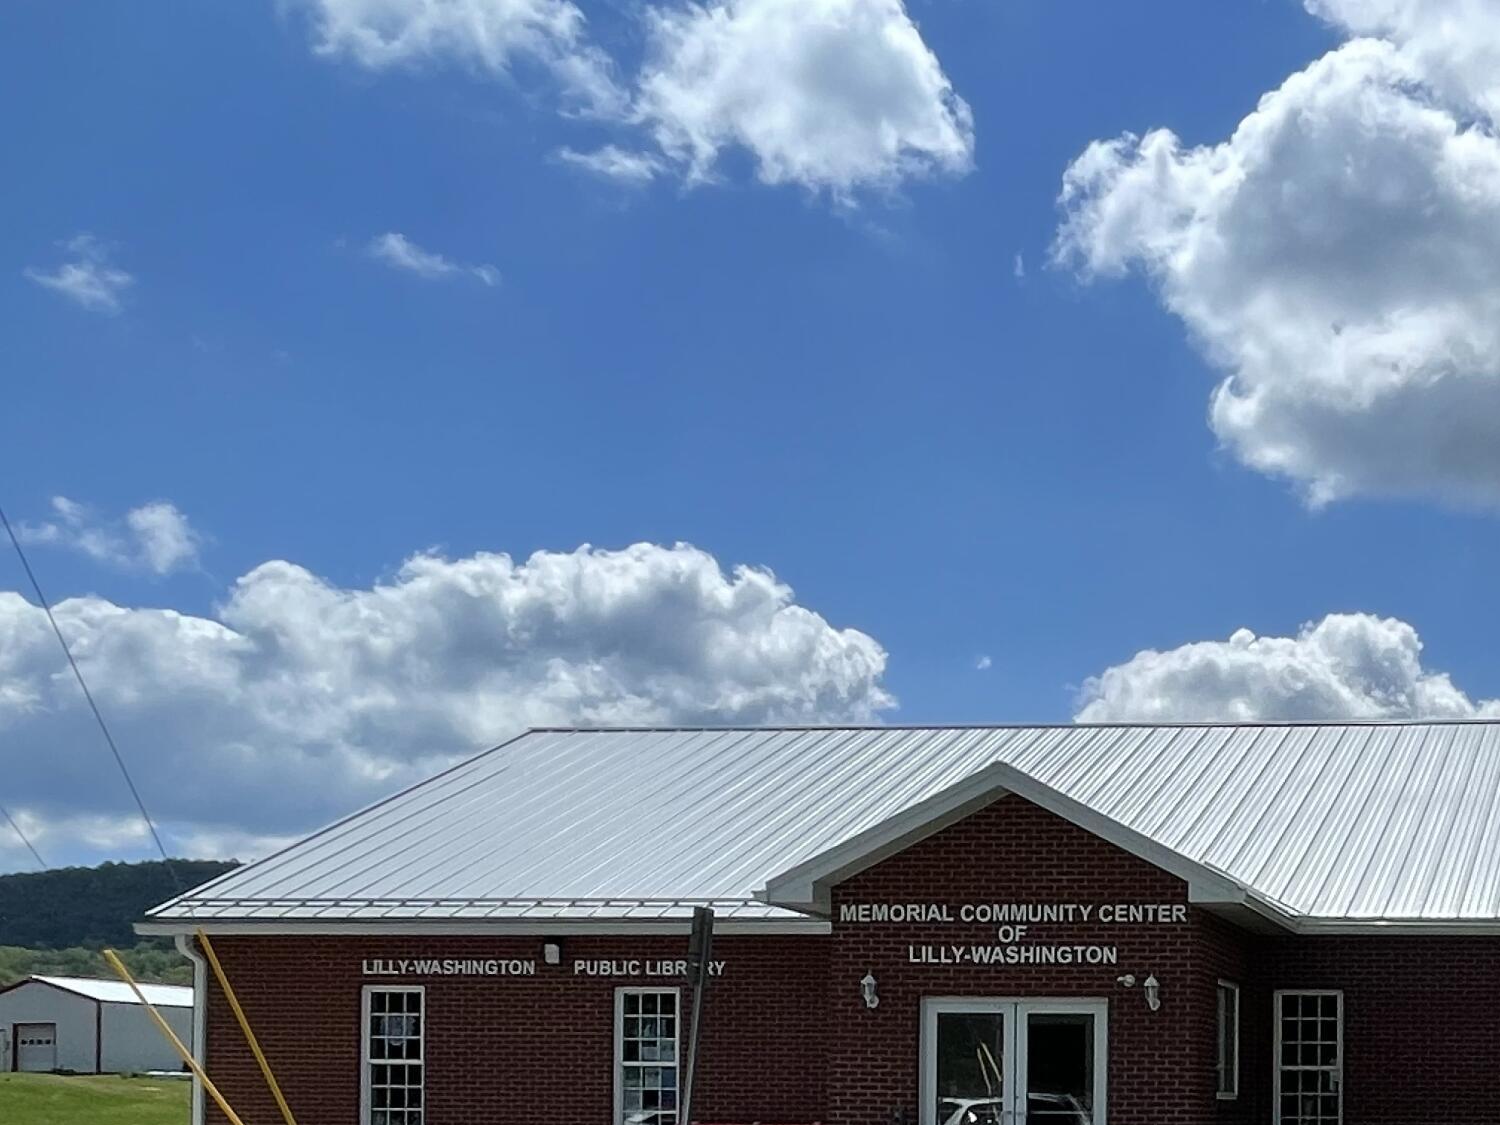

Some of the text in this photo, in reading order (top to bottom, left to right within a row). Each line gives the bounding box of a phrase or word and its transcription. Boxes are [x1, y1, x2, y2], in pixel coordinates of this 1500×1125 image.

[840, 904, 1187, 922] MEMORIAL COMMUNITY CENTER
[998, 925, 1027, 943] OF
[909, 946, 1117, 964] LILLY-WASHINGTON
[362, 959, 726, 976] LILLY-WASHINGTON PUBLIC LIBRRY
